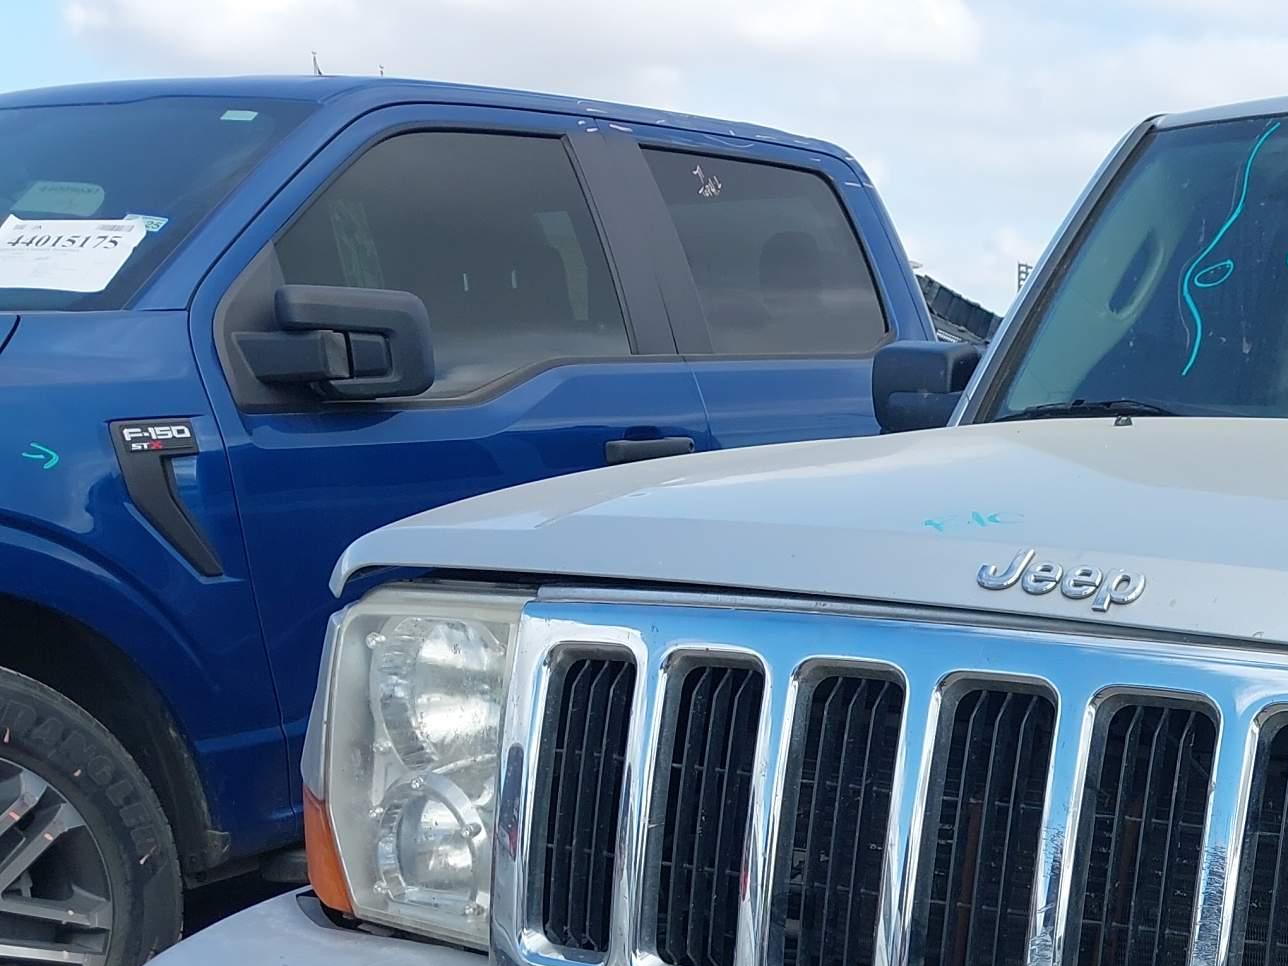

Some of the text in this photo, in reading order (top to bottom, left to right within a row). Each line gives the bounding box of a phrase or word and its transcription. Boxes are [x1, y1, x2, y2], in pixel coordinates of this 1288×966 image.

[7, 234, 123, 249] 44015175
[122, 425, 191, 441] F-150
[131, 440, 164, 451] STX
[975, 548, 1146, 613] Jeep
